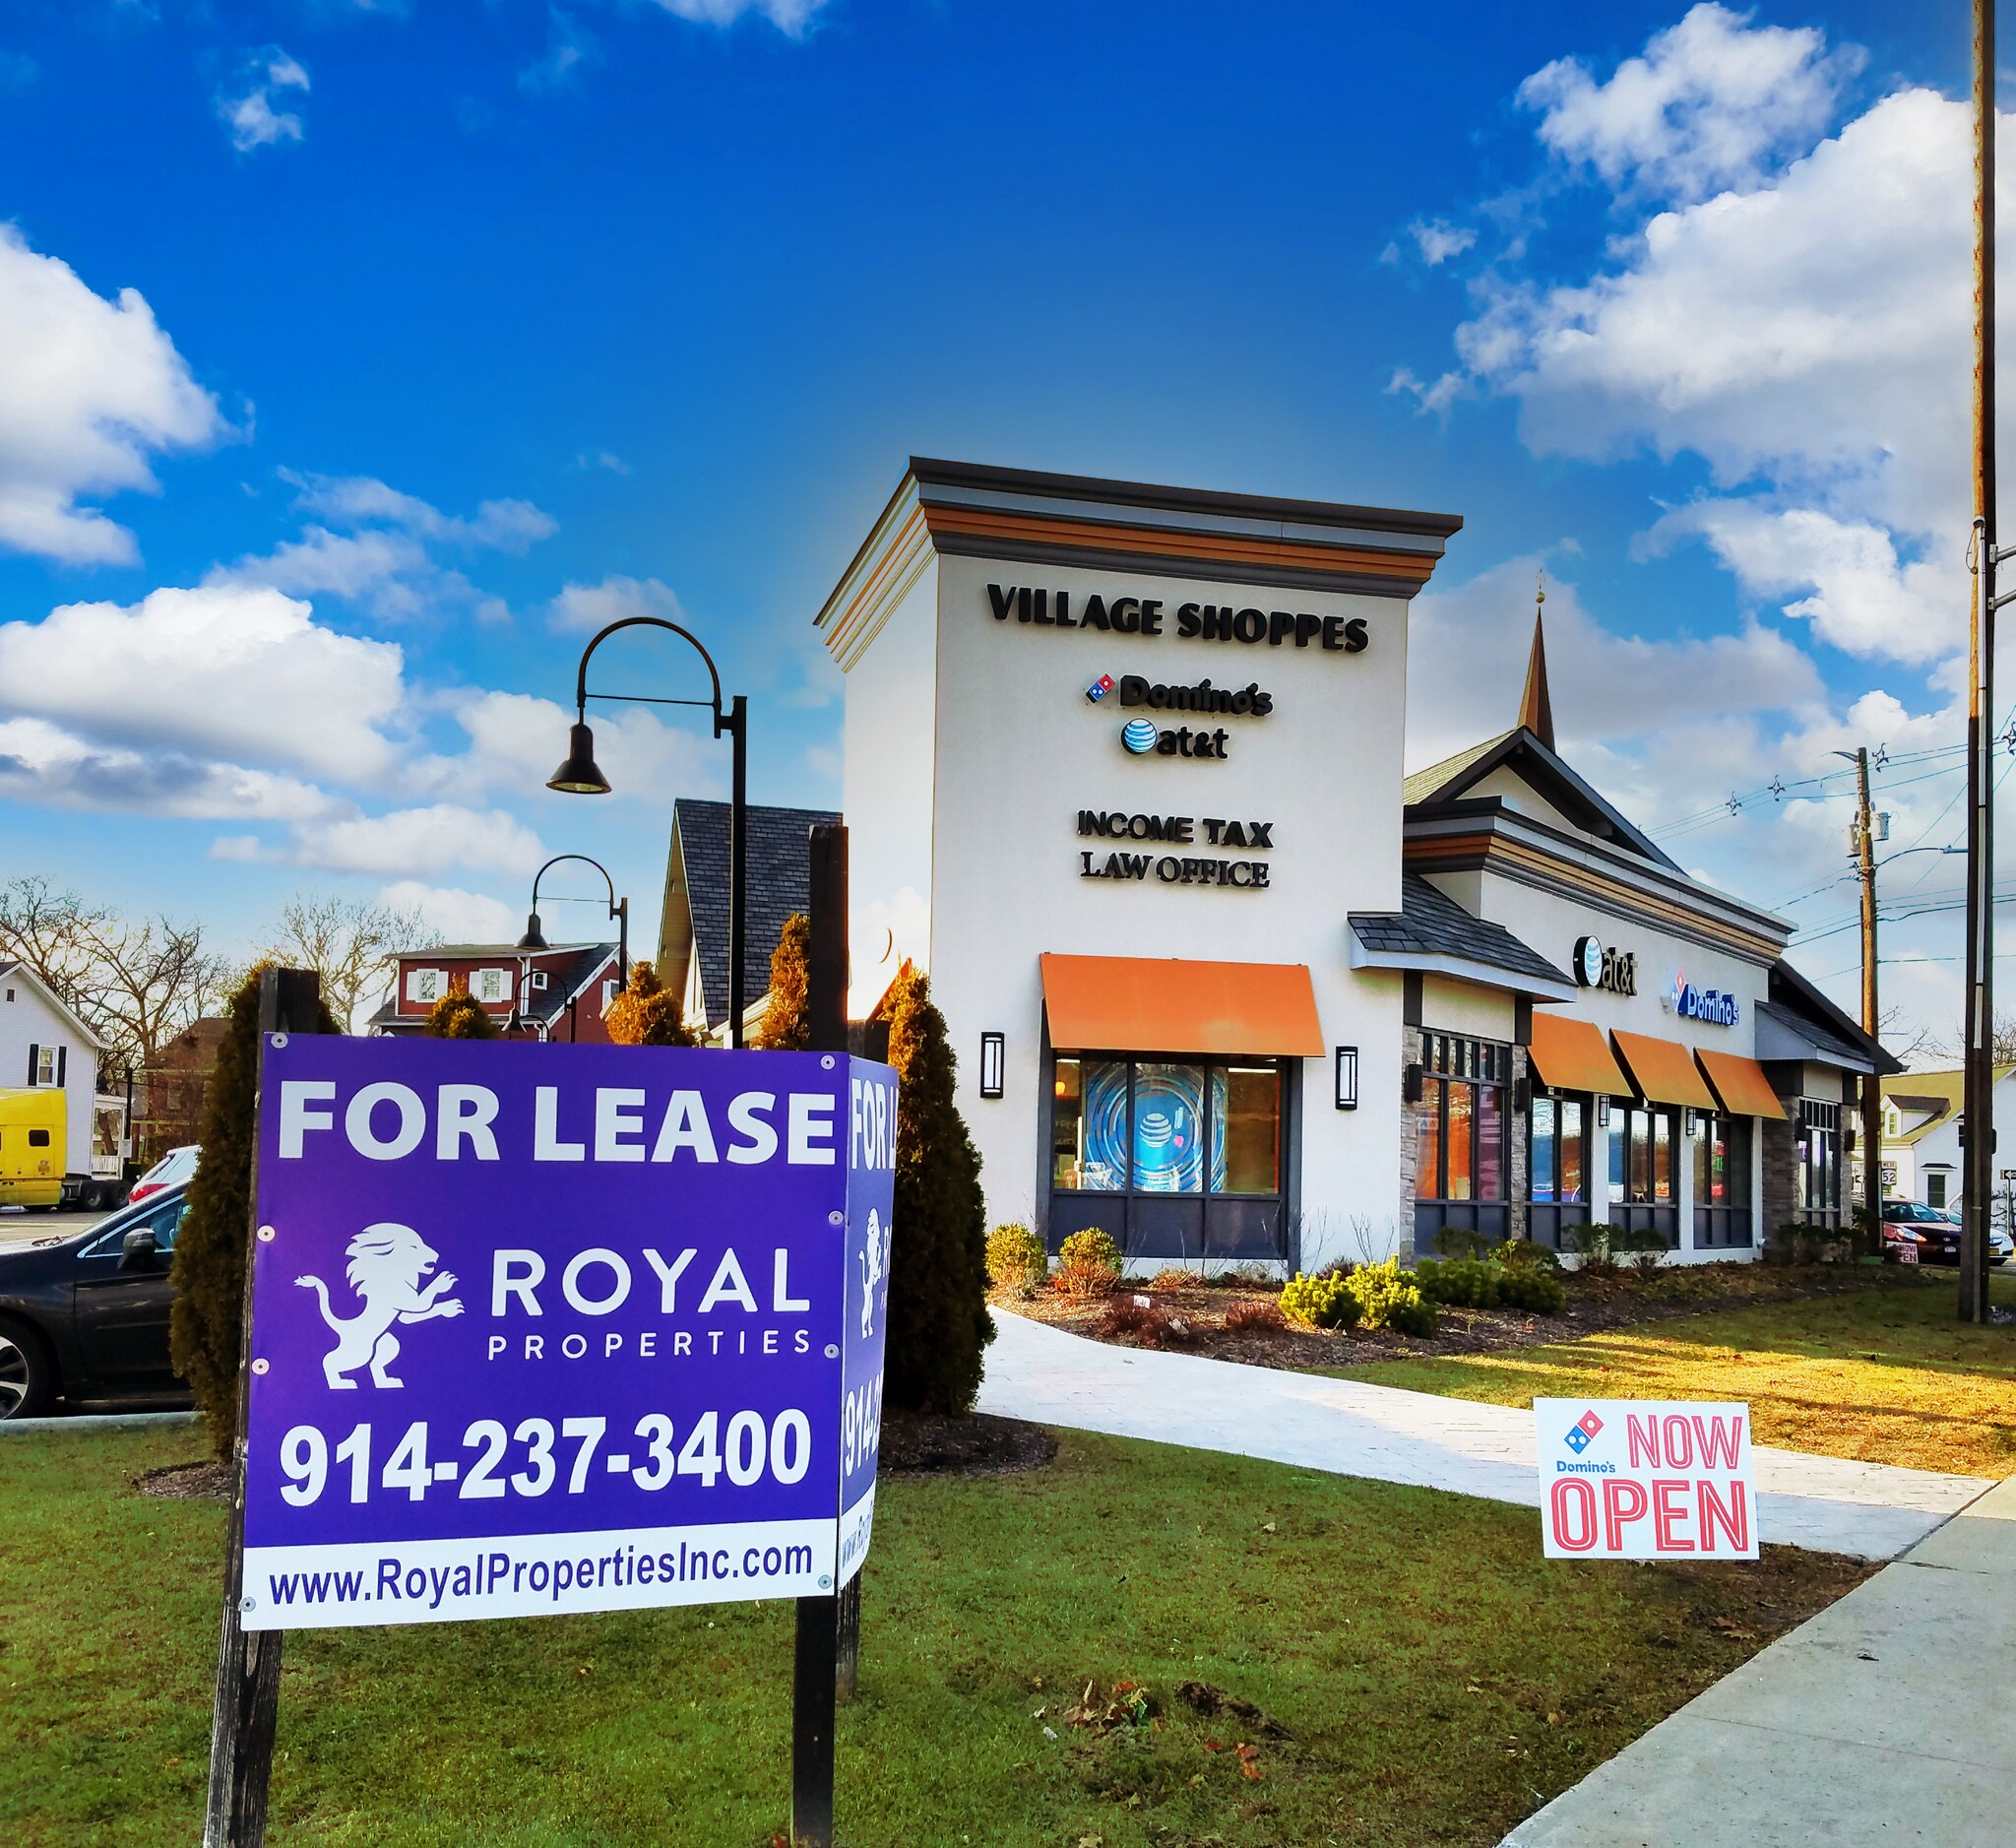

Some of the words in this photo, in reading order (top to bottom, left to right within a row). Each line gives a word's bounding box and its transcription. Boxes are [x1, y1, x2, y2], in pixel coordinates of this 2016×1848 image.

[986, 583, 1164, 635] VILLAGE
[1177, 603, 1369, 653] SHOPPES
[1120, 674, 1274, 716] Domino's
[1157, 727, 1229, 758] at&t
[1078, 810, 1194, 844] INCOME
[1203, 818, 1274, 849] TAX
[1081, 852, 1154, 880] LAW
[1156, 856, 1270, 888] OFFICE
[1602, 946, 1638, 996] at&t
[1686, 985, 1738, 1025] Domino's
[279, 1081, 500, 1161] FOR
[535, 1087, 836, 1166] LEASE
[851, 1077, 887, 1170] FOR
[1882, 1173, 1896, 1182] 52
[491, 1248, 809, 1316] ROYAL
[488, 1329, 809, 1361] PROPERTIES
[280, 1409, 810, 1506] 914-237-3400
[1556, 1460, 1616, 1474] Domino's
[1626, 1414, 1742, 1470] NOW
[1550, 1477, 1748, 1552] OPEN
[270, 1542, 813, 1609] www.RoyalPropertiesInc.com
